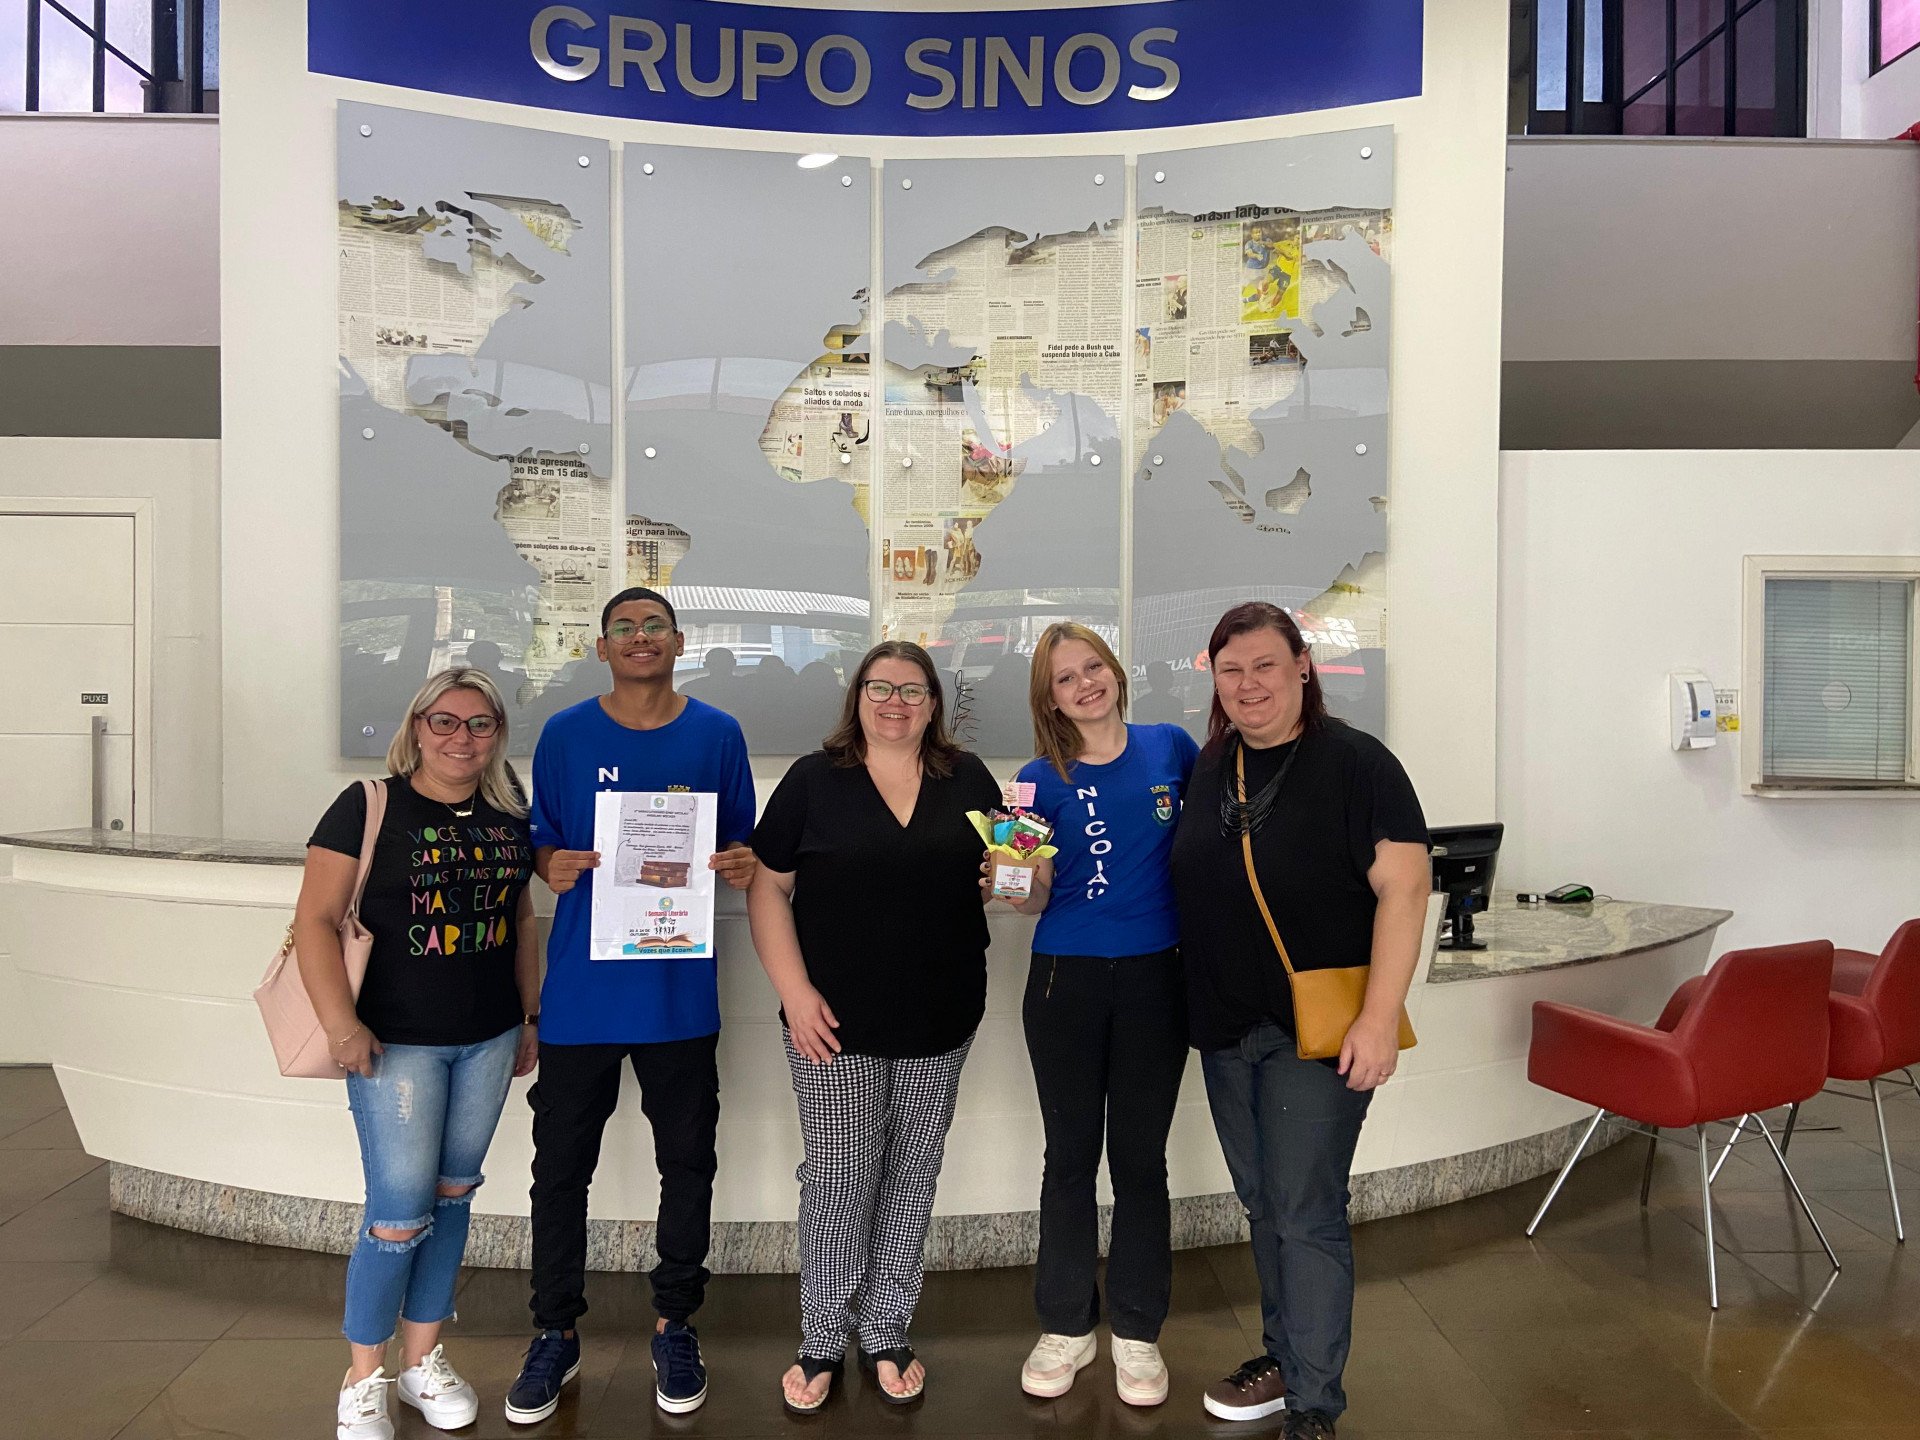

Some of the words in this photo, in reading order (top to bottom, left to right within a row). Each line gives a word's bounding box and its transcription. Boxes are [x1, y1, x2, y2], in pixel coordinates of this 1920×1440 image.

[530, 5, 871, 106] GRUPO
[905, 27, 1181, 108] SINOS
[1065, 344, 1079, 352] pede
[1103, 344, 1114, 352] que
[804, 388, 827, 396] Saltos
[835, 390, 862, 398] solados
[804, 398, 830, 406] aliados
[885, 408, 903, 416] Entre
[903, 407, 925, 417] dunas,
[925, 407, 960, 418] mergulhos
[517, 456, 538, 464] deve
[528, 466, 539, 475] RS
[541, 468, 554, 476] em
[557, 469, 568, 477] 15
[570, 469, 588, 479] dias
[645, 528, 665, 537] para
[82, 694, 107, 703] PUXE
[474, 846, 531, 861] QUANTAS
[409, 871, 449, 887] VIDAS
[411, 887, 461, 915] MAS
